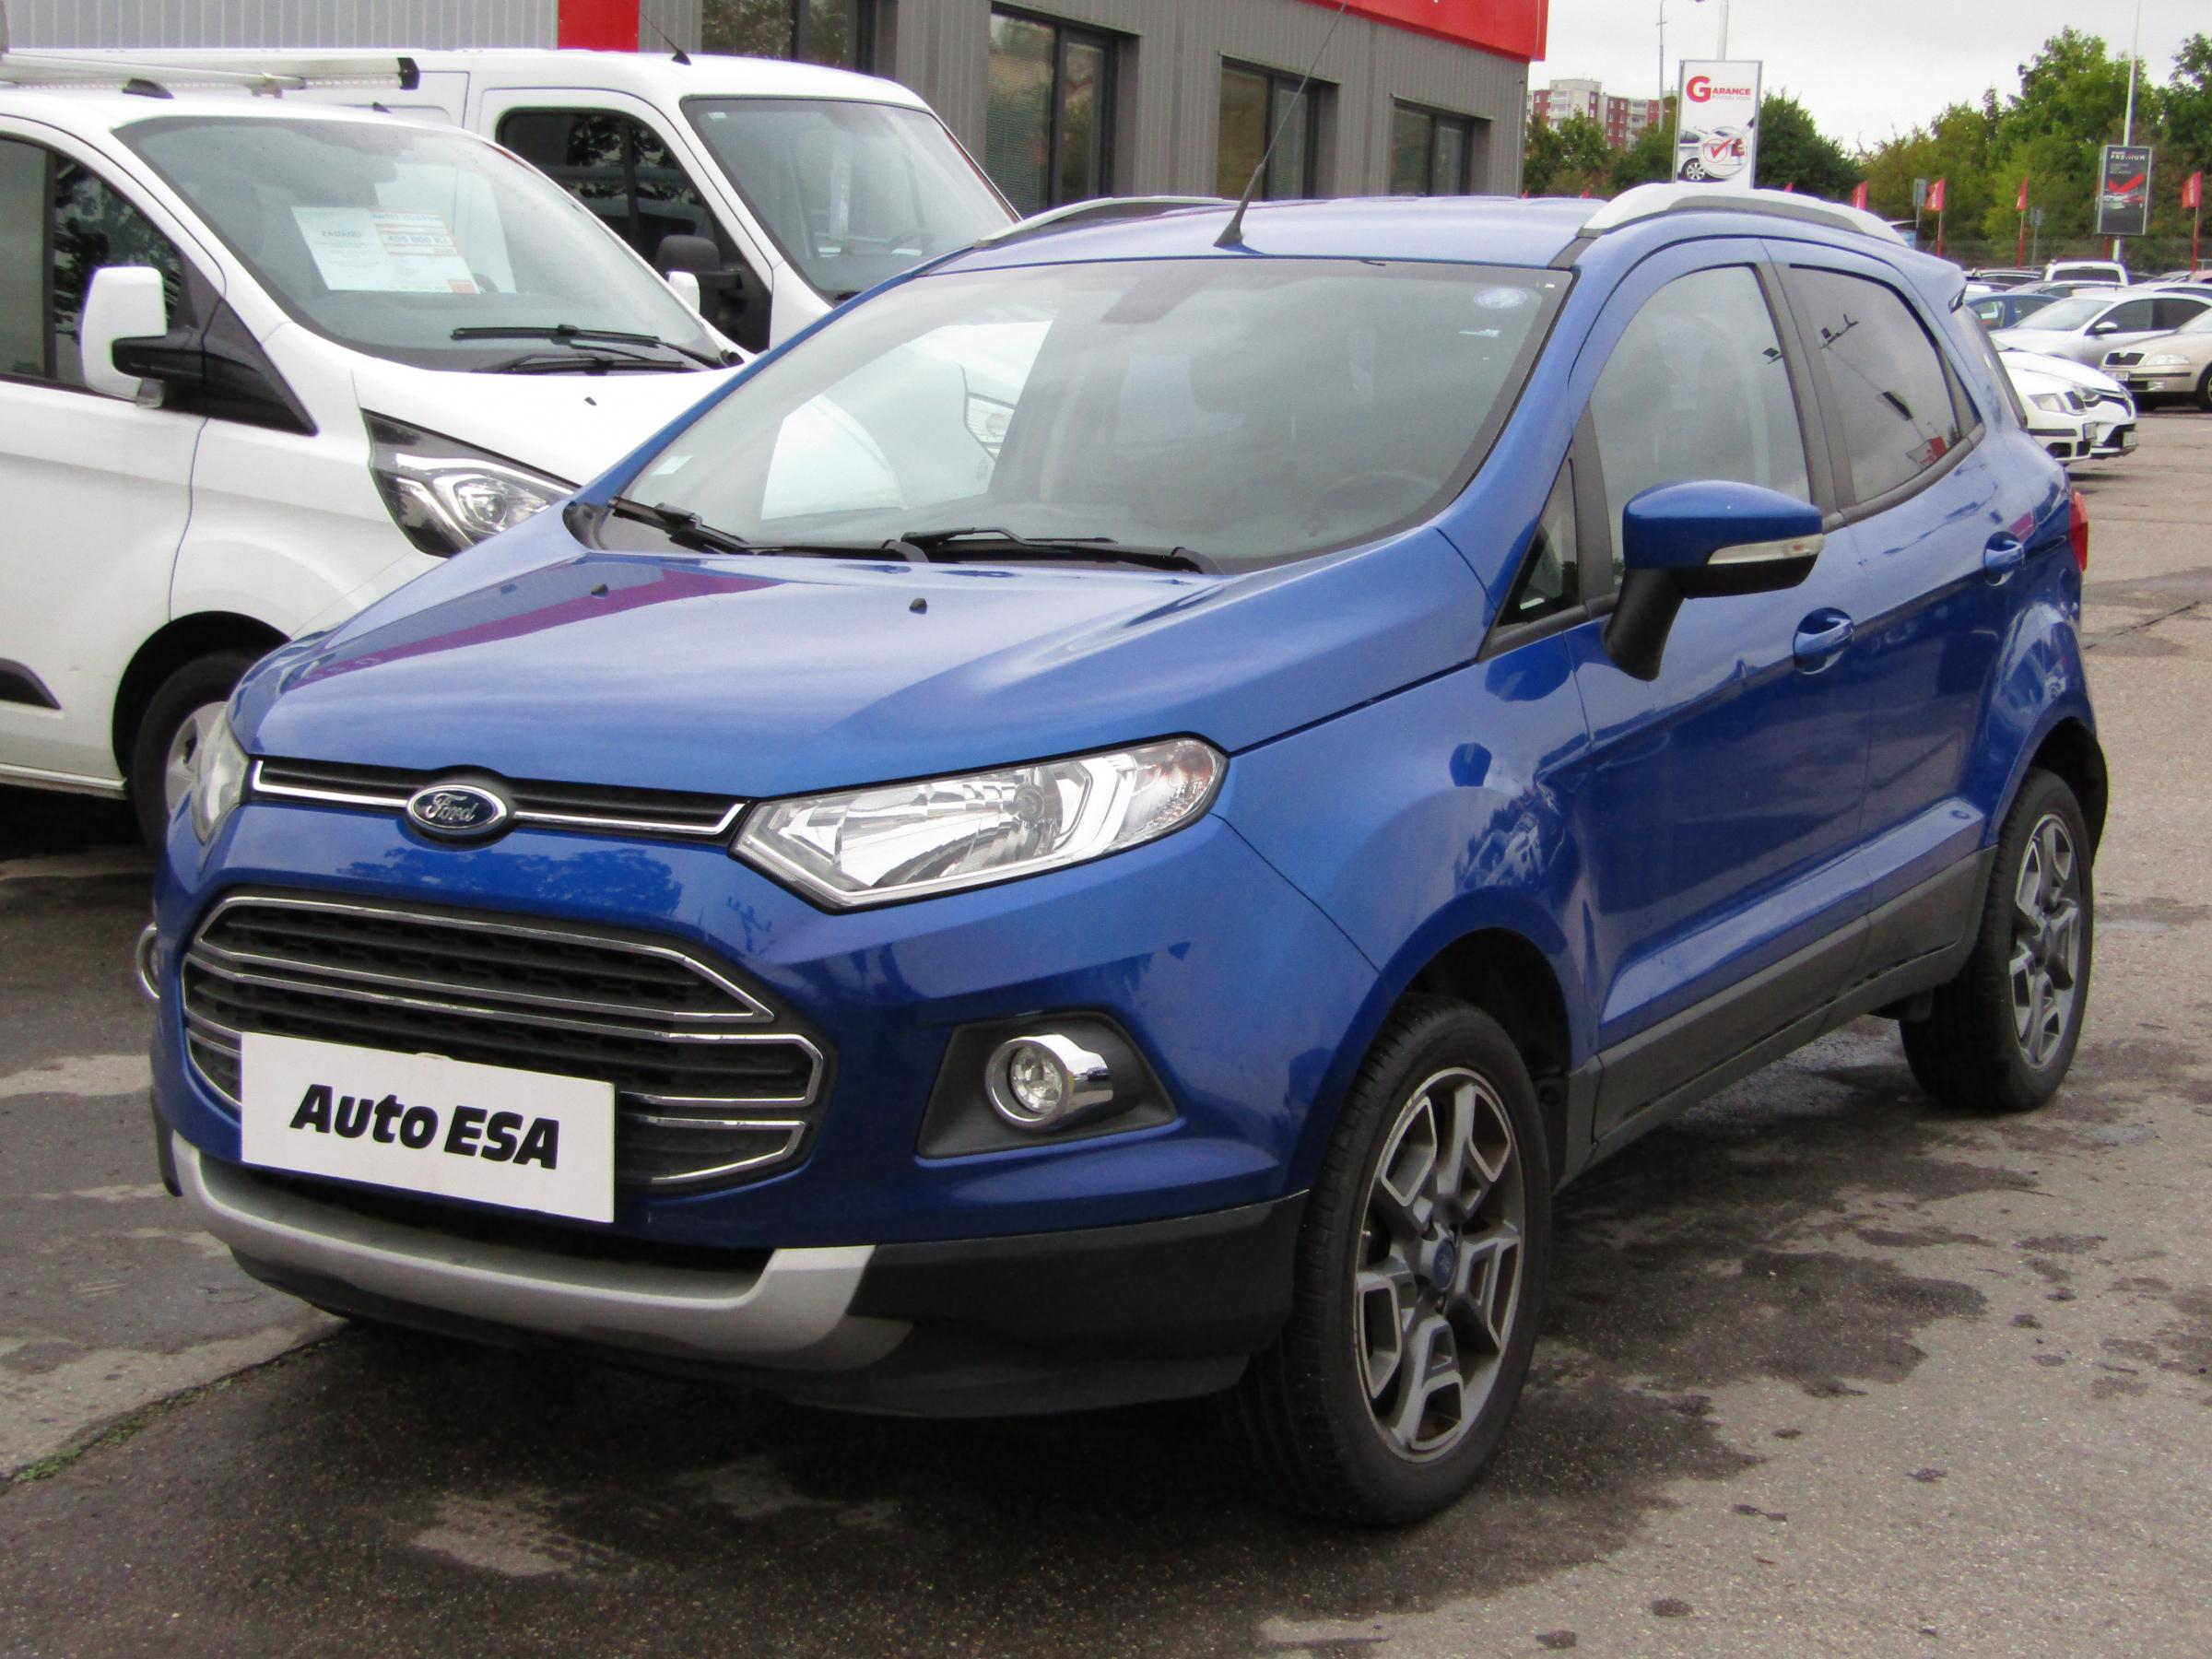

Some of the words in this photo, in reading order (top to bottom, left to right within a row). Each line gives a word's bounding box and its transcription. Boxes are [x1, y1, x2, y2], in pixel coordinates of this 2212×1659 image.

[1686, 76, 1752, 103] GARANCE
[425, 792, 479, 822] Ford
[289, 1083, 439, 1149] Auto
[443, 1105, 559, 1171] ESA
